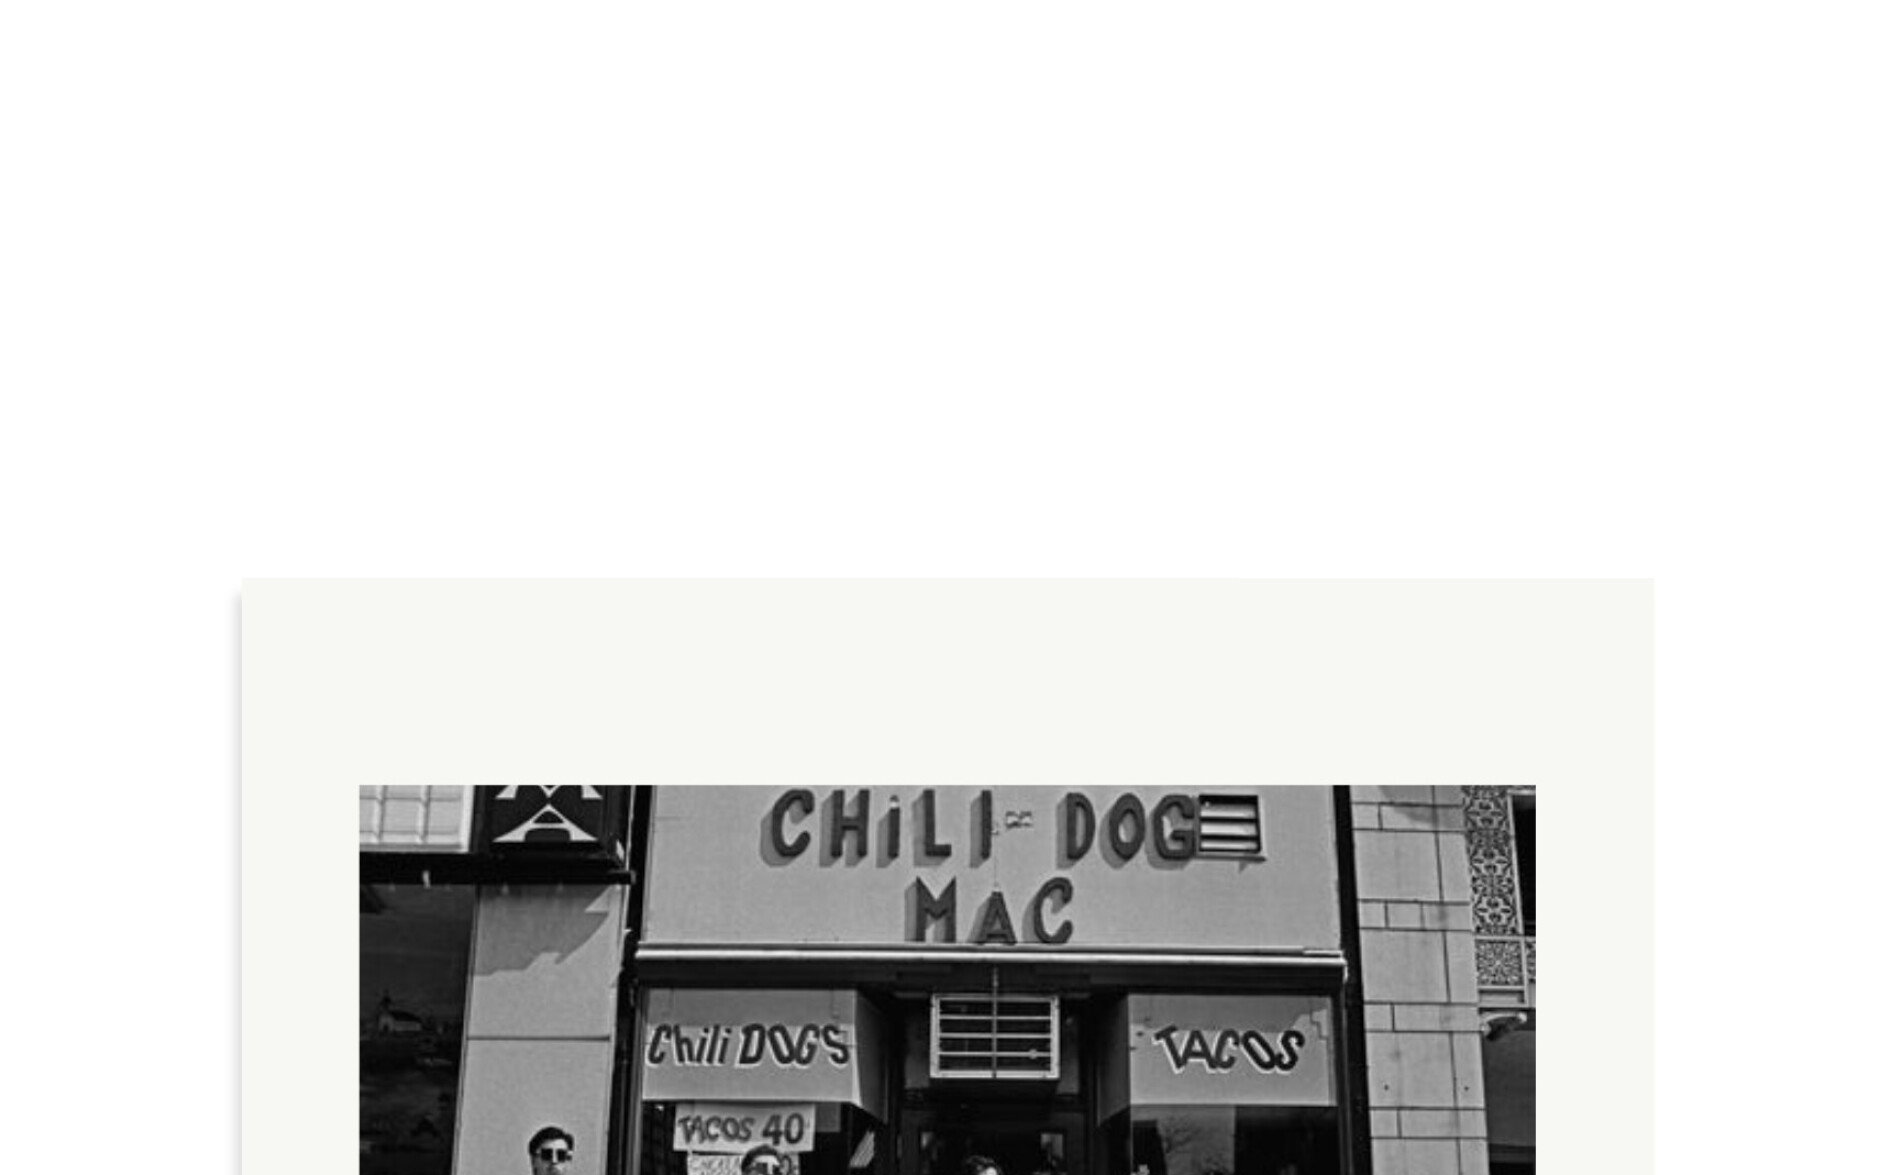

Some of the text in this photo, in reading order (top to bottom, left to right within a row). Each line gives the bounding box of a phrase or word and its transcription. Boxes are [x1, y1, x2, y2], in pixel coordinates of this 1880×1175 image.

[1056, 792, 1196, 870] DOG
[905, 876, 1073, 945] MAC
[648, 1023, 850, 1067] Chili DOGS
[1153, 1025, 1306, 1073] TACOS
[678, 1113, 804, 1146] TACOS 40
